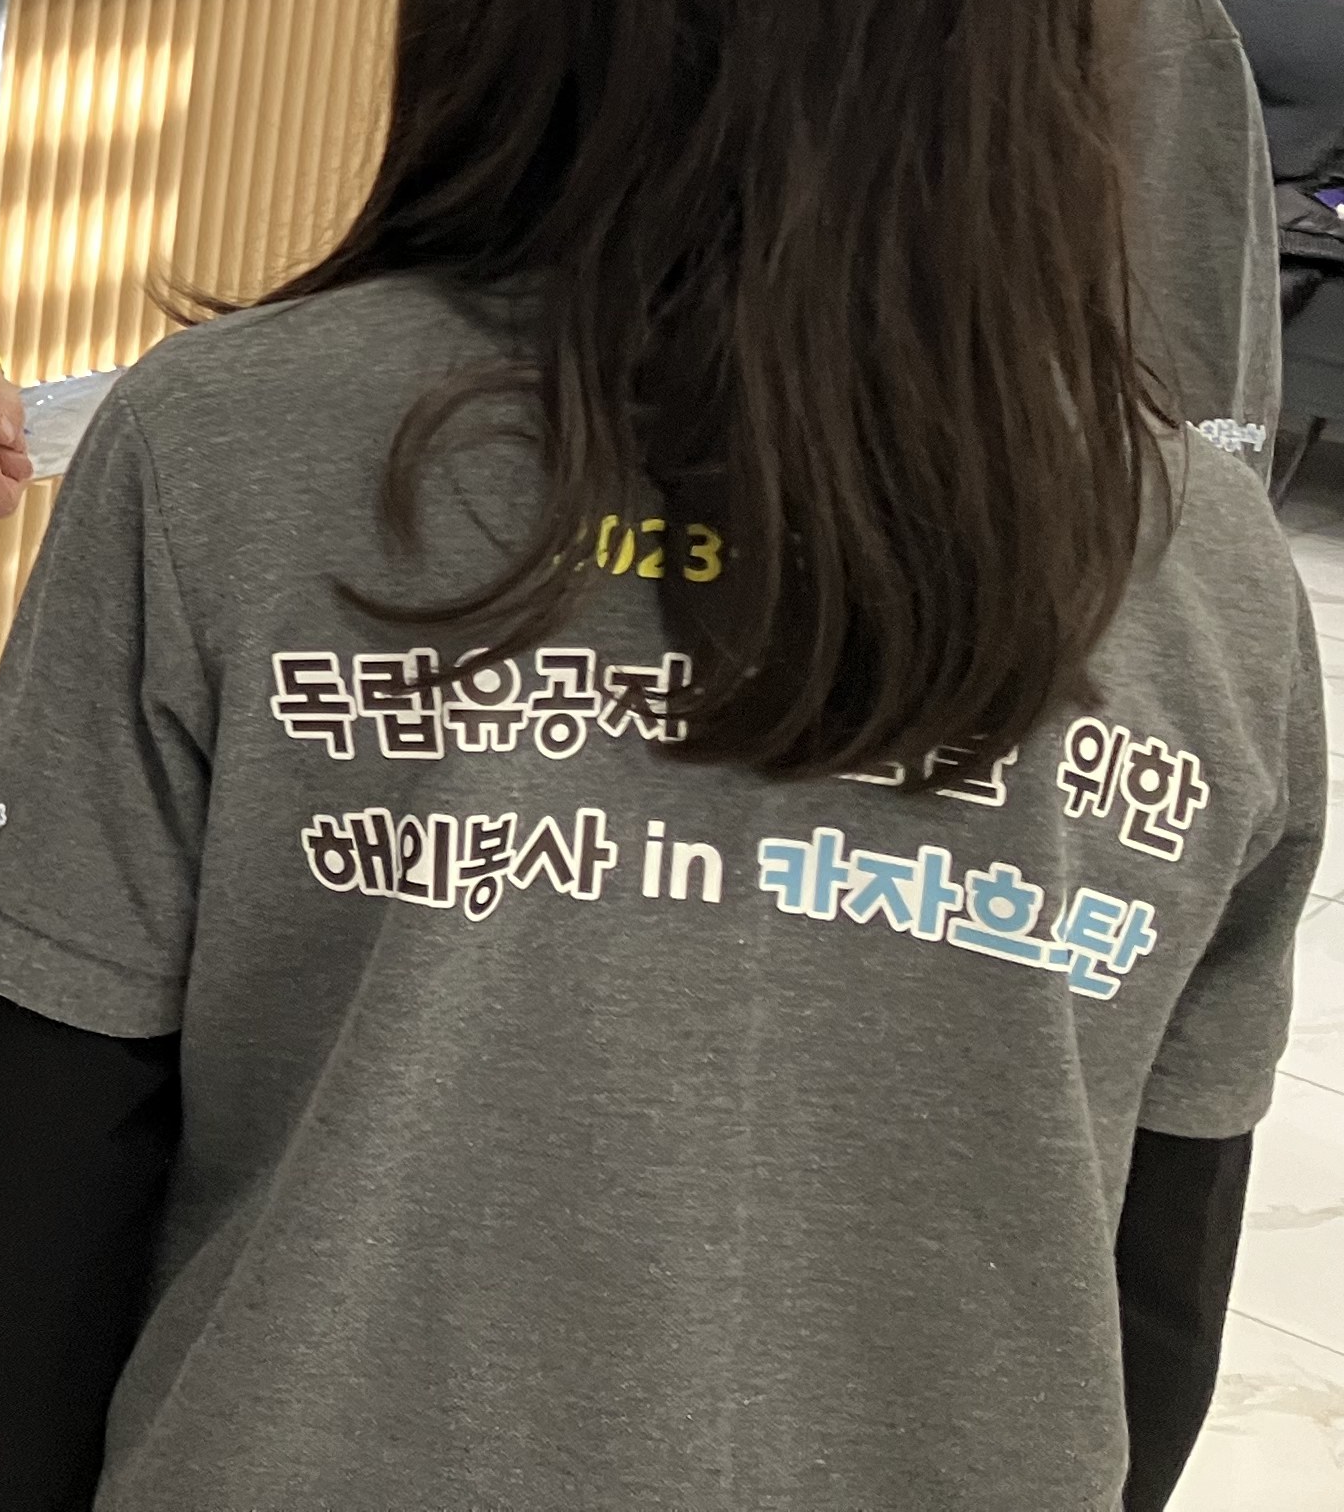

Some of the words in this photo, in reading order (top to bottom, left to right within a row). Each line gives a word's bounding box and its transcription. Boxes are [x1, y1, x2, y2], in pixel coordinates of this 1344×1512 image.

[270, 646, 694, 761] 독립유공자
[1056, 715, 1210, 863] 위한
[300, 807, 619, 922] 해외봉사
[642, 819, 723, 905] in
